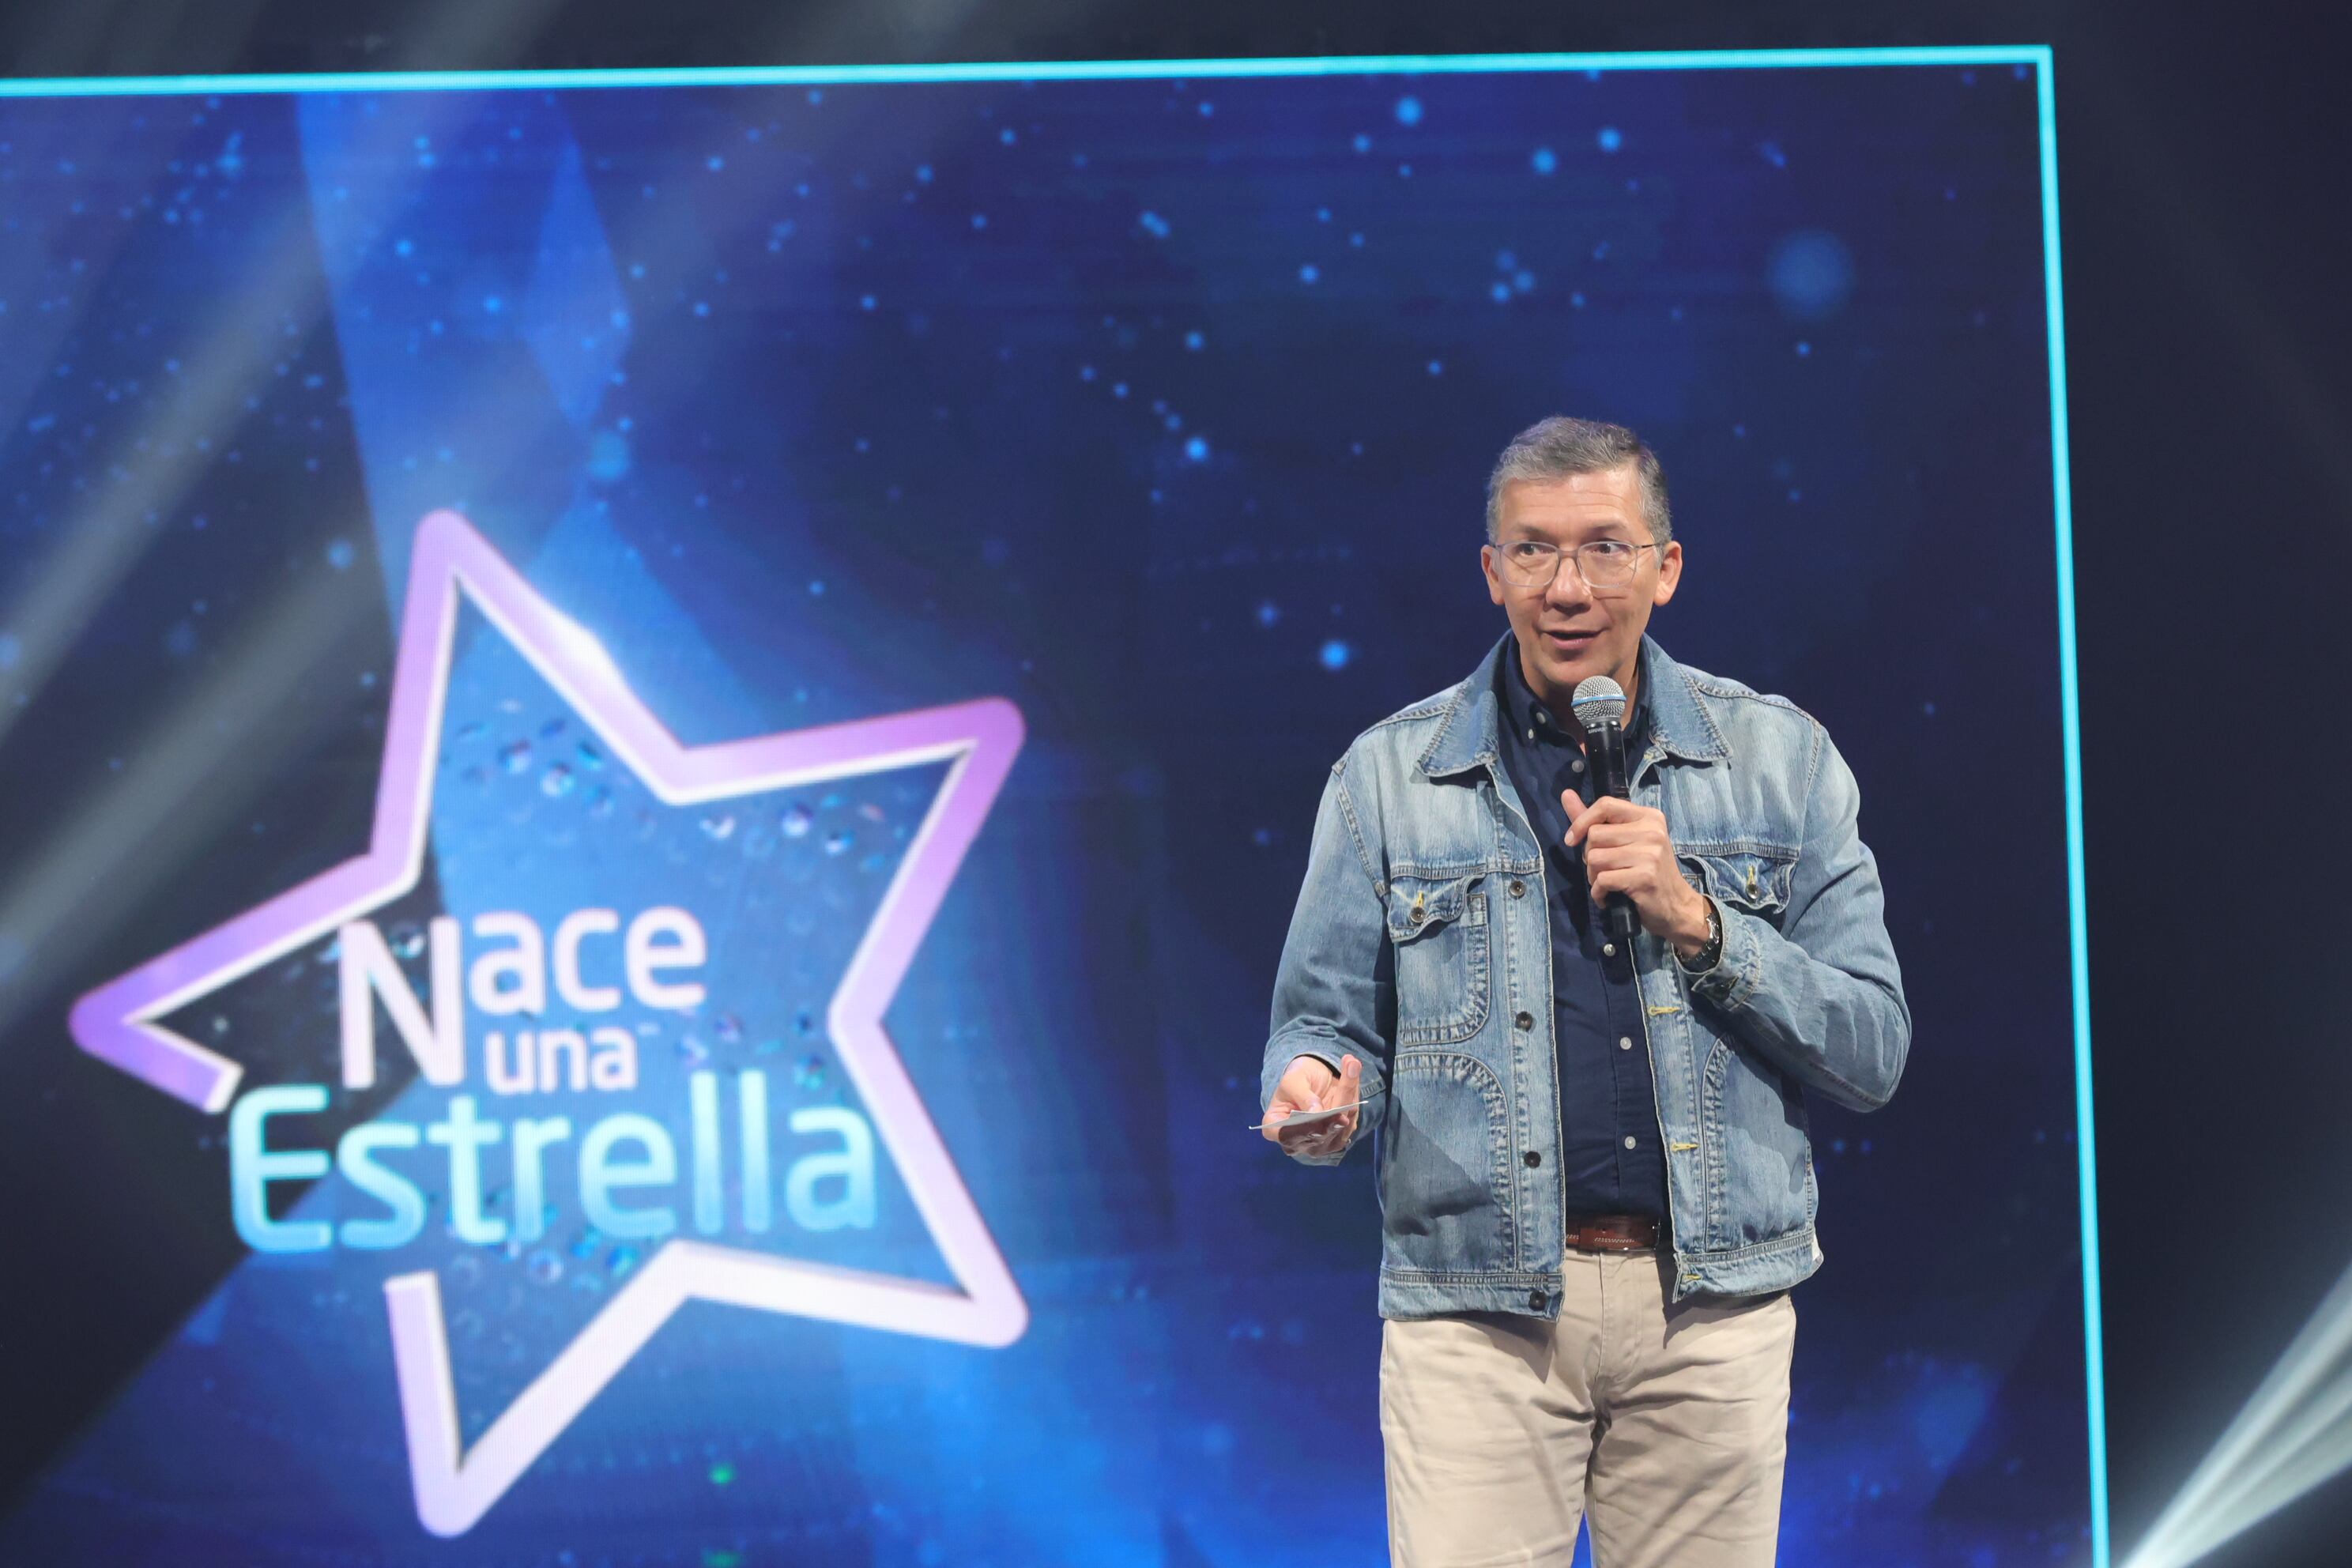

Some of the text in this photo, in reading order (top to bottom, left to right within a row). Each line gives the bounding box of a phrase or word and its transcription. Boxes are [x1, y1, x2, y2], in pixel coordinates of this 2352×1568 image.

[338, 906, 707, 1089] Nace
[484, 1027, 638, 1095] una
[229, 1069, 877, 1253] Estrella
